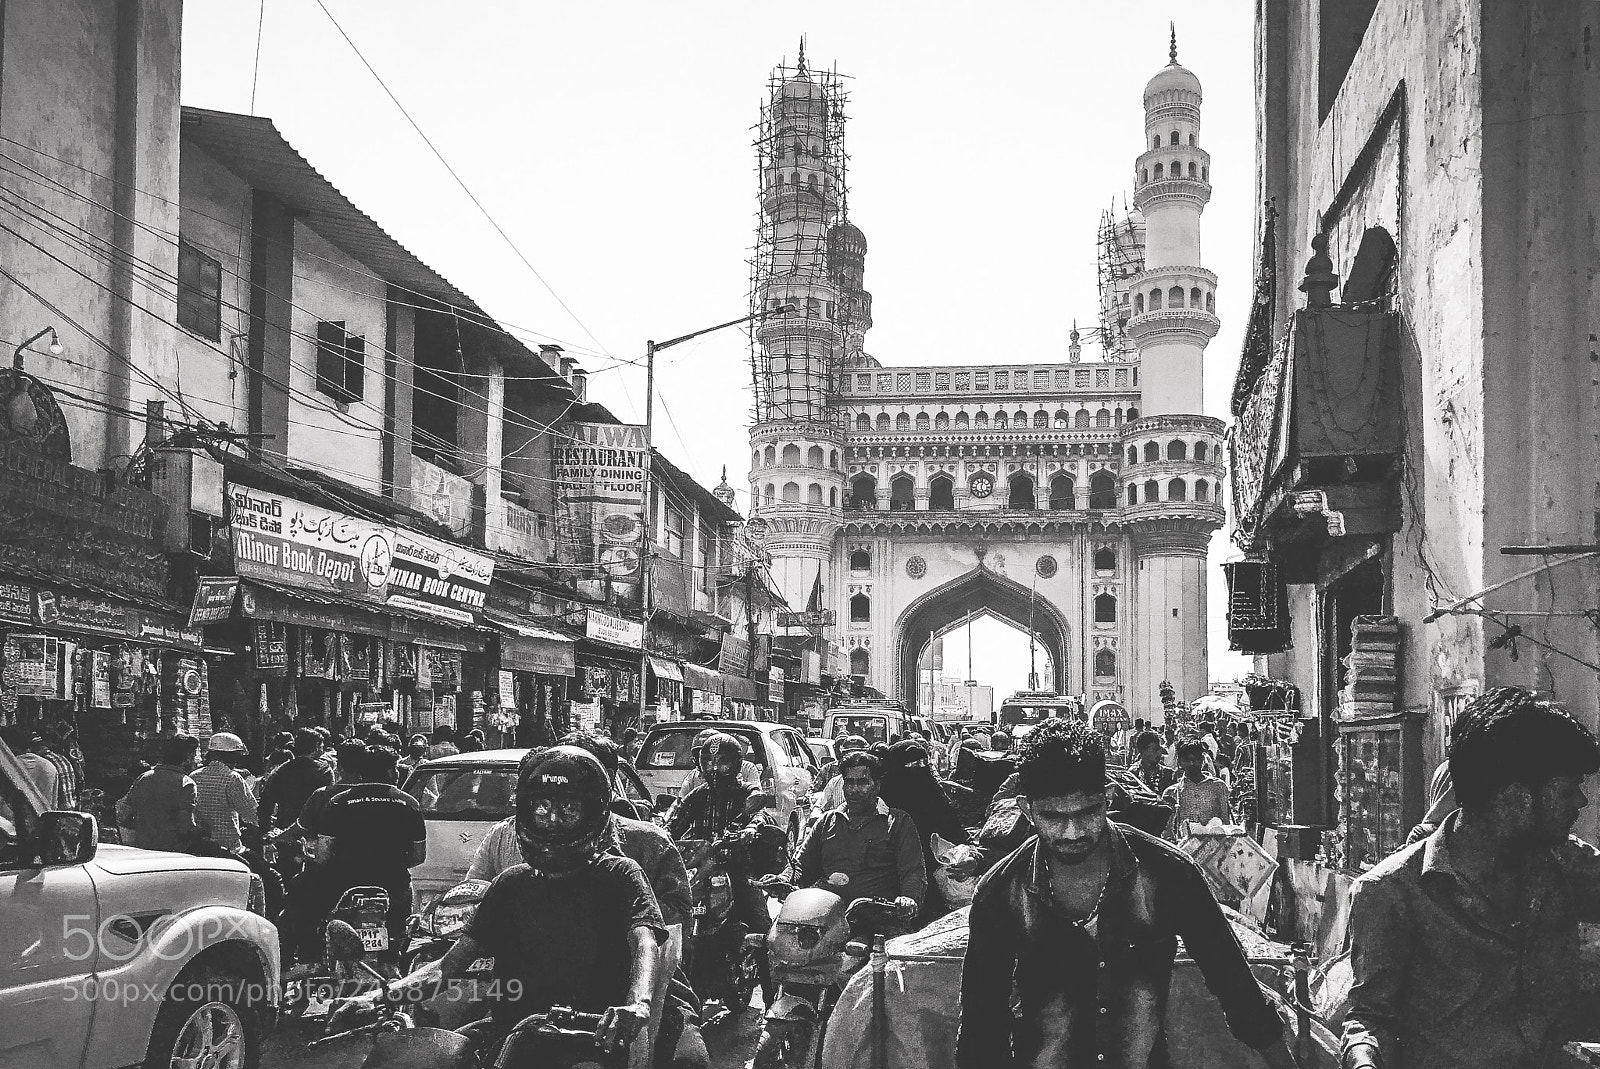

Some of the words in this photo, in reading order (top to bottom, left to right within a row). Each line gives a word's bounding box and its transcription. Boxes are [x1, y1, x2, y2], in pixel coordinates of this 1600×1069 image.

[553, 447, 645, 467] RESTAURANT
[557, 468, 597, 478] FAMILY
[601, 469, 642, 480] DINING
[604, 481, 643, 492] FLOOR
[237, 531, 278, 567] Minar
[282, 542, 314, 575] Book
[317, 551, 356, 584] Depot
[388, 567, 422, 590] MINAR
[422, 577, 450, 598] BOOK
[450, 584, 486, 608] CENTRE
[1099, 708, 1123, 717] IMAX
